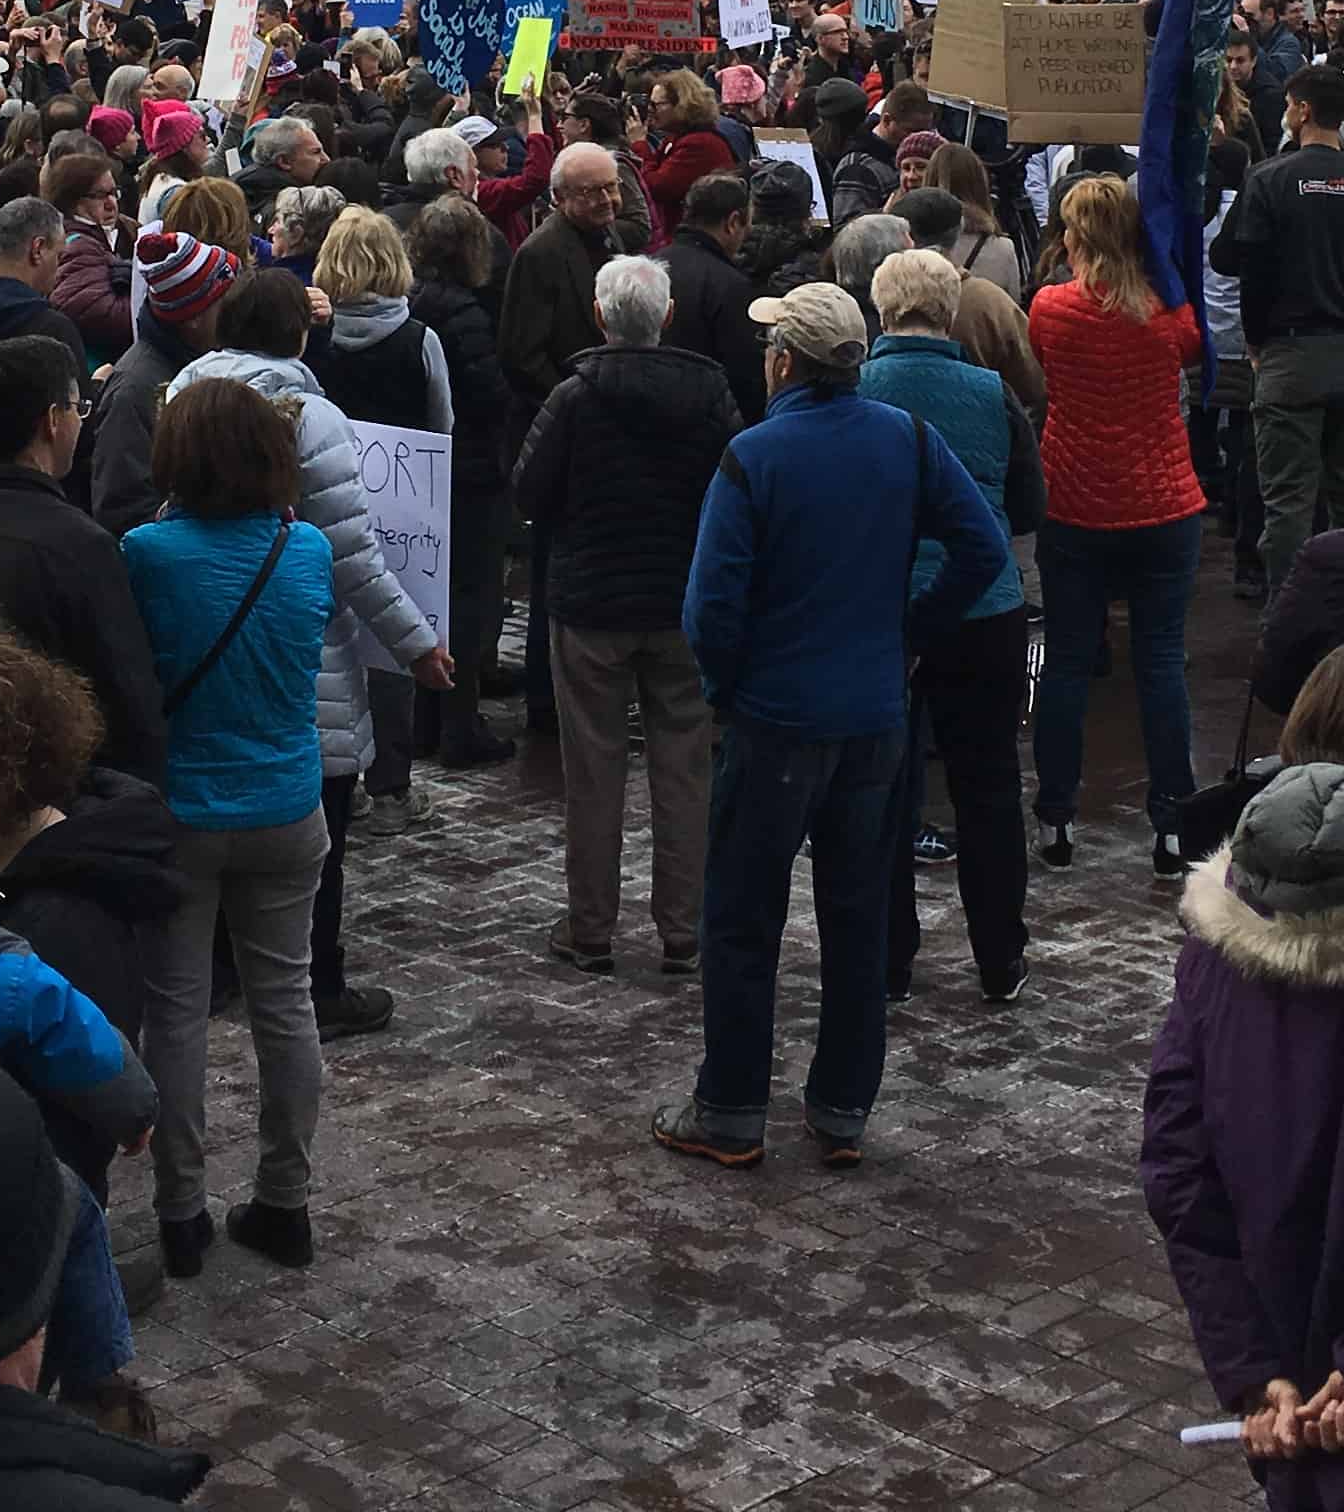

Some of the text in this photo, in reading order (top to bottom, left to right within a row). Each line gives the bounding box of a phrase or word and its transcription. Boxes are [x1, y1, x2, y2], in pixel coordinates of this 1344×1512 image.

[636, 7, 690, 20] DECISION
[608, 22, 657, 34] MAKING
[1047, 11, 1104, 32] RATHER
[1113, 10, 1135, 30] BE
[1023, 56, 1033, 71] A
